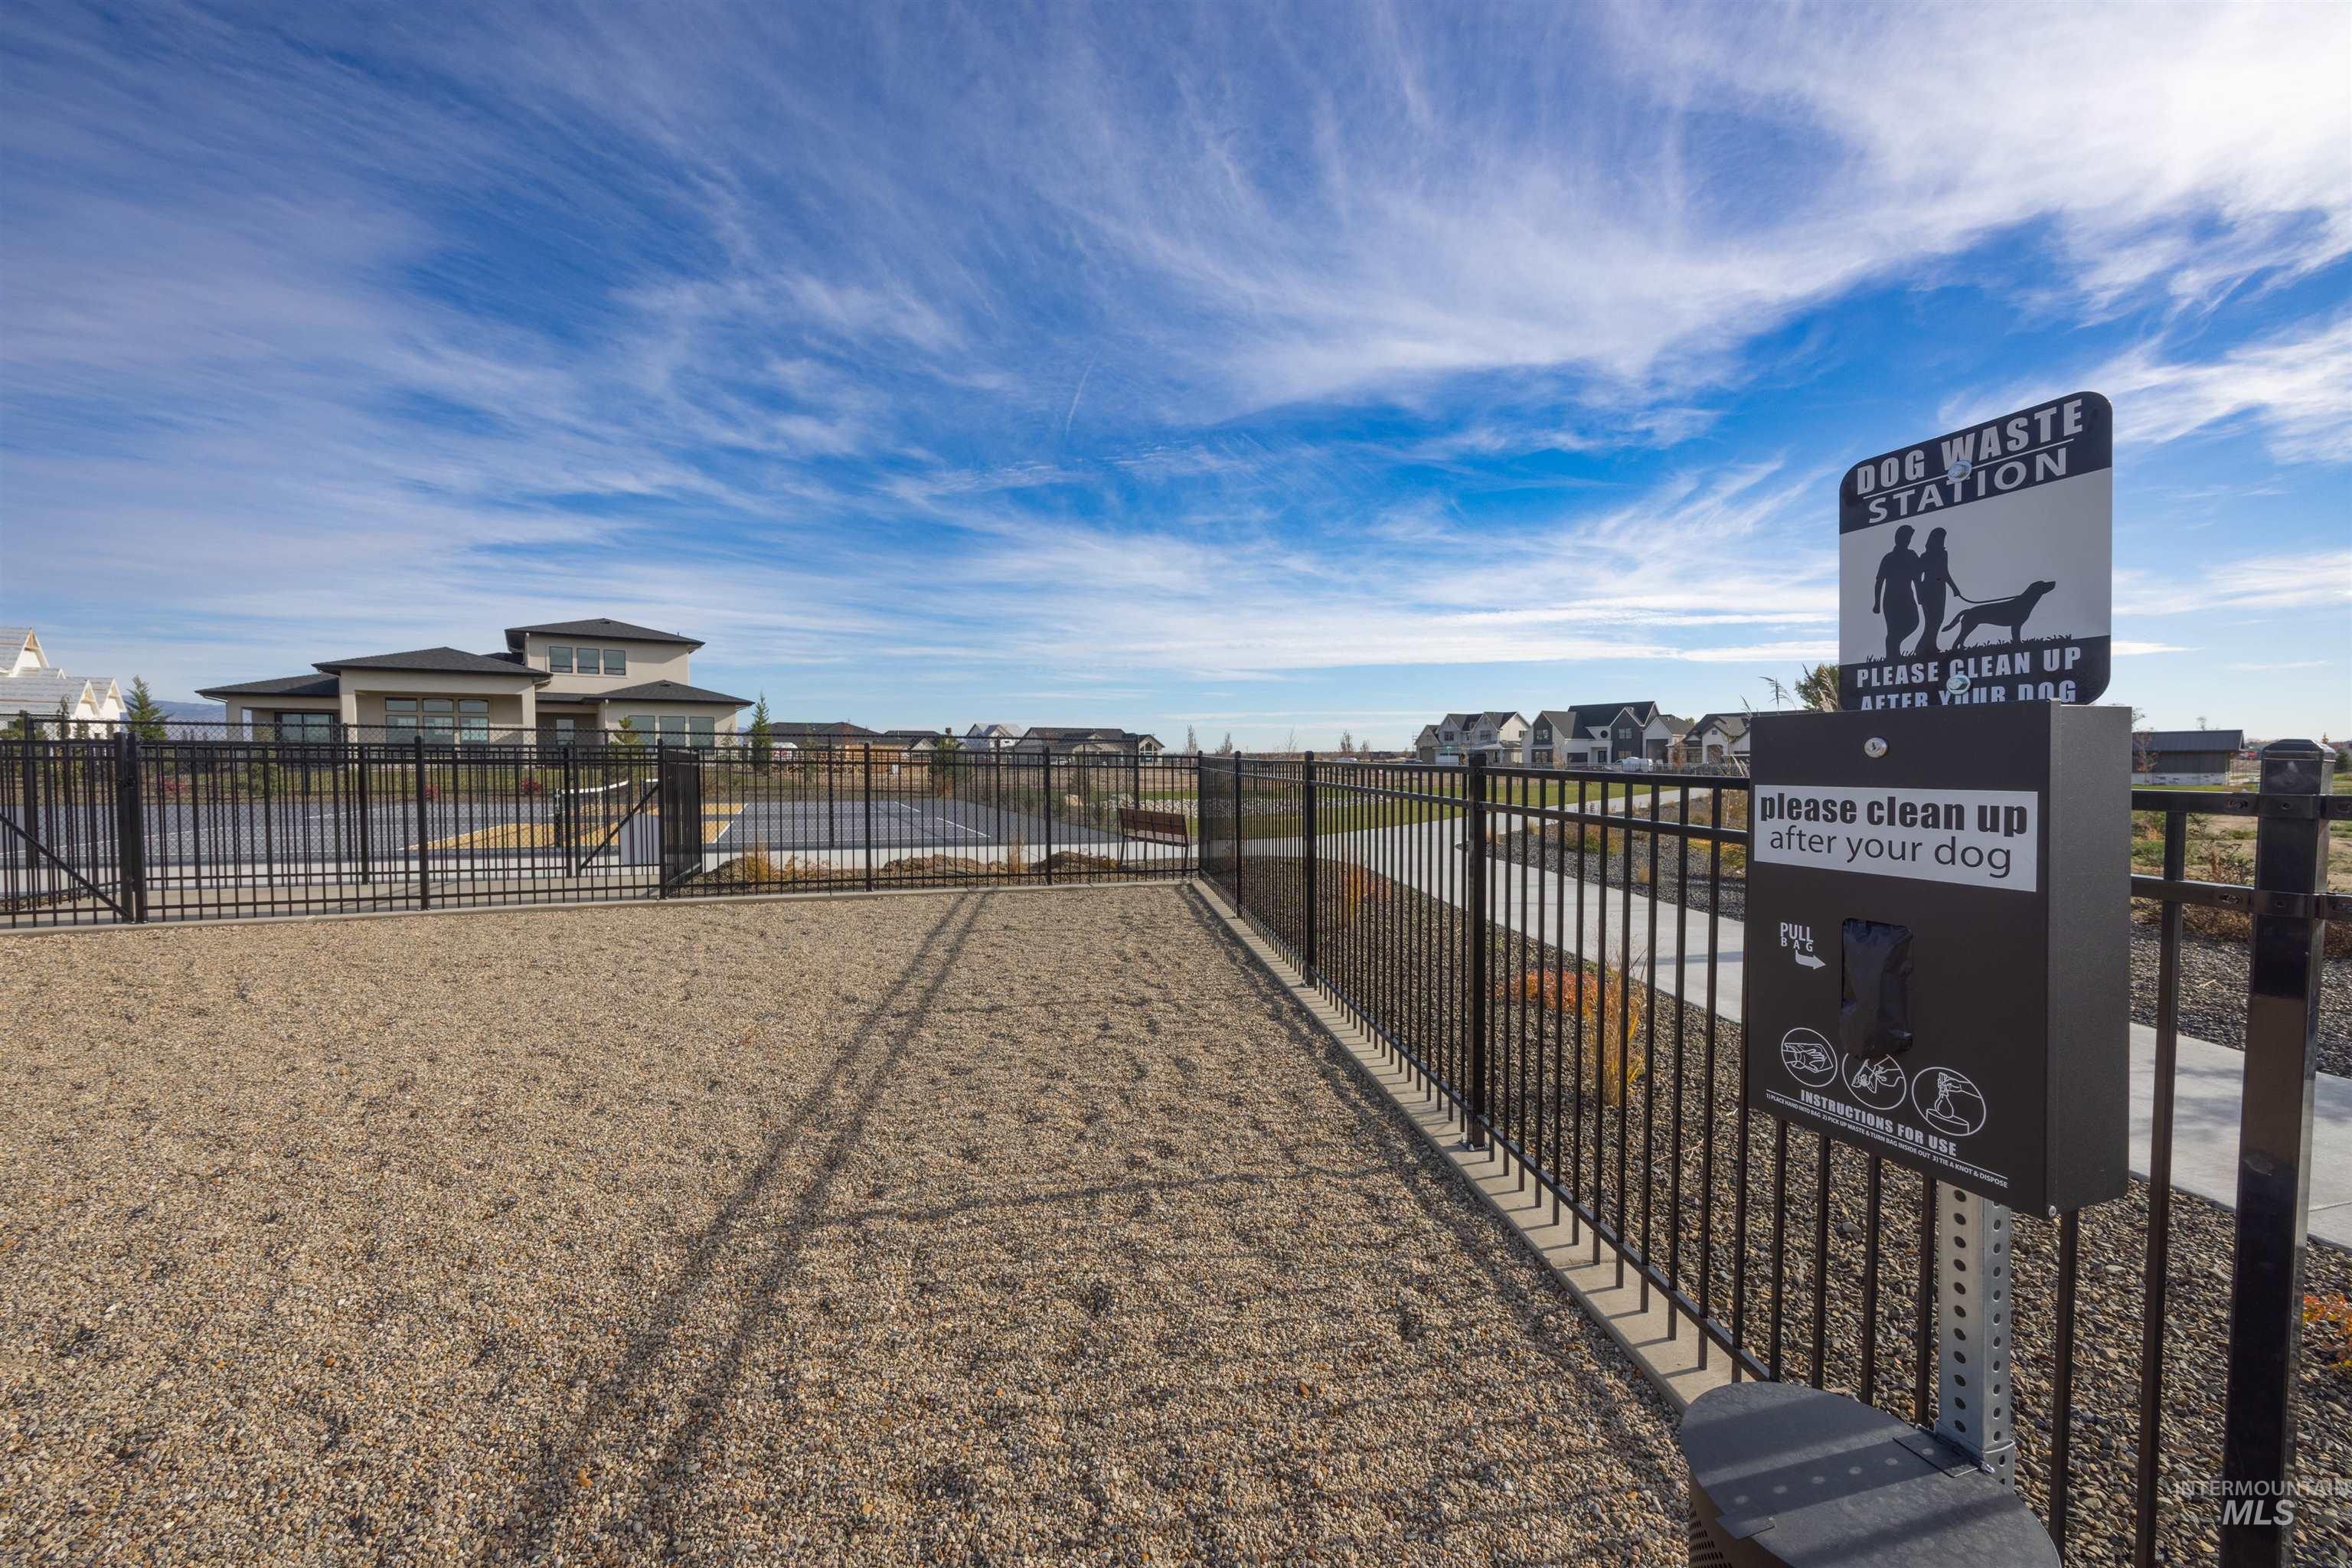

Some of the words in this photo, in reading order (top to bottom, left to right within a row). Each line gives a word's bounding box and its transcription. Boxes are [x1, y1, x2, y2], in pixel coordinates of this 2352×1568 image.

[1857, 449, 1925, 495] DOG
[1941, 398, 2082, 471] WASTE
[1868, 447, 2066, 524] STATION
[1857, 662, 1939, 688] PLEASE
[1949, 651, 2030, 680] CLEAN
[2043, 646, 2081, 671] UP
[1860, 691, 1929, 711] AFTER
[2018, 680, 2076, 702] DOG
[1761, 792, 1857, 825] please
[1867, 796, 1965, 831] clean
[1977, 805, 2027, 838] up
[1770, 825, 1837, 854] after
[1846, 838, 1922, 863] your
[1934, 836, 2011, 878] dog
[1780, 922, 1814, 942] PULL
[1770, 1096, 1785, 1104] PLACE
[1785, 1100, 1799, 1109] HAND
[1798, 1106, 1811, 1114] INTO
[1811, 1109, 1821, 1118] BAG
[1828, 1116, 1840, 1125] PICK
[1847, 1124, 1865, 1135] WASTE
[1870, 1133, 1886, 1142] TURN
[1886, 1138, 1898, 1147] BAG
[1899, 1142, 1918, 1155] INSIDE
[1918, 1150, 1931, 1159] OUT
[1932, 1155, 1939, 1163] 3)
[1939, 1157, 1949, 1166] TIE
[1955, 1164, 1973, 1175] KNOT
[1980, 1173, 2009, 1188] DISPOSE
[1801, 1089, 1893, 1133] INSTRUCTIONS
[1897, 1123, 1924, 1145] FOR
[1929, 1134, 1957, 1157] USE
